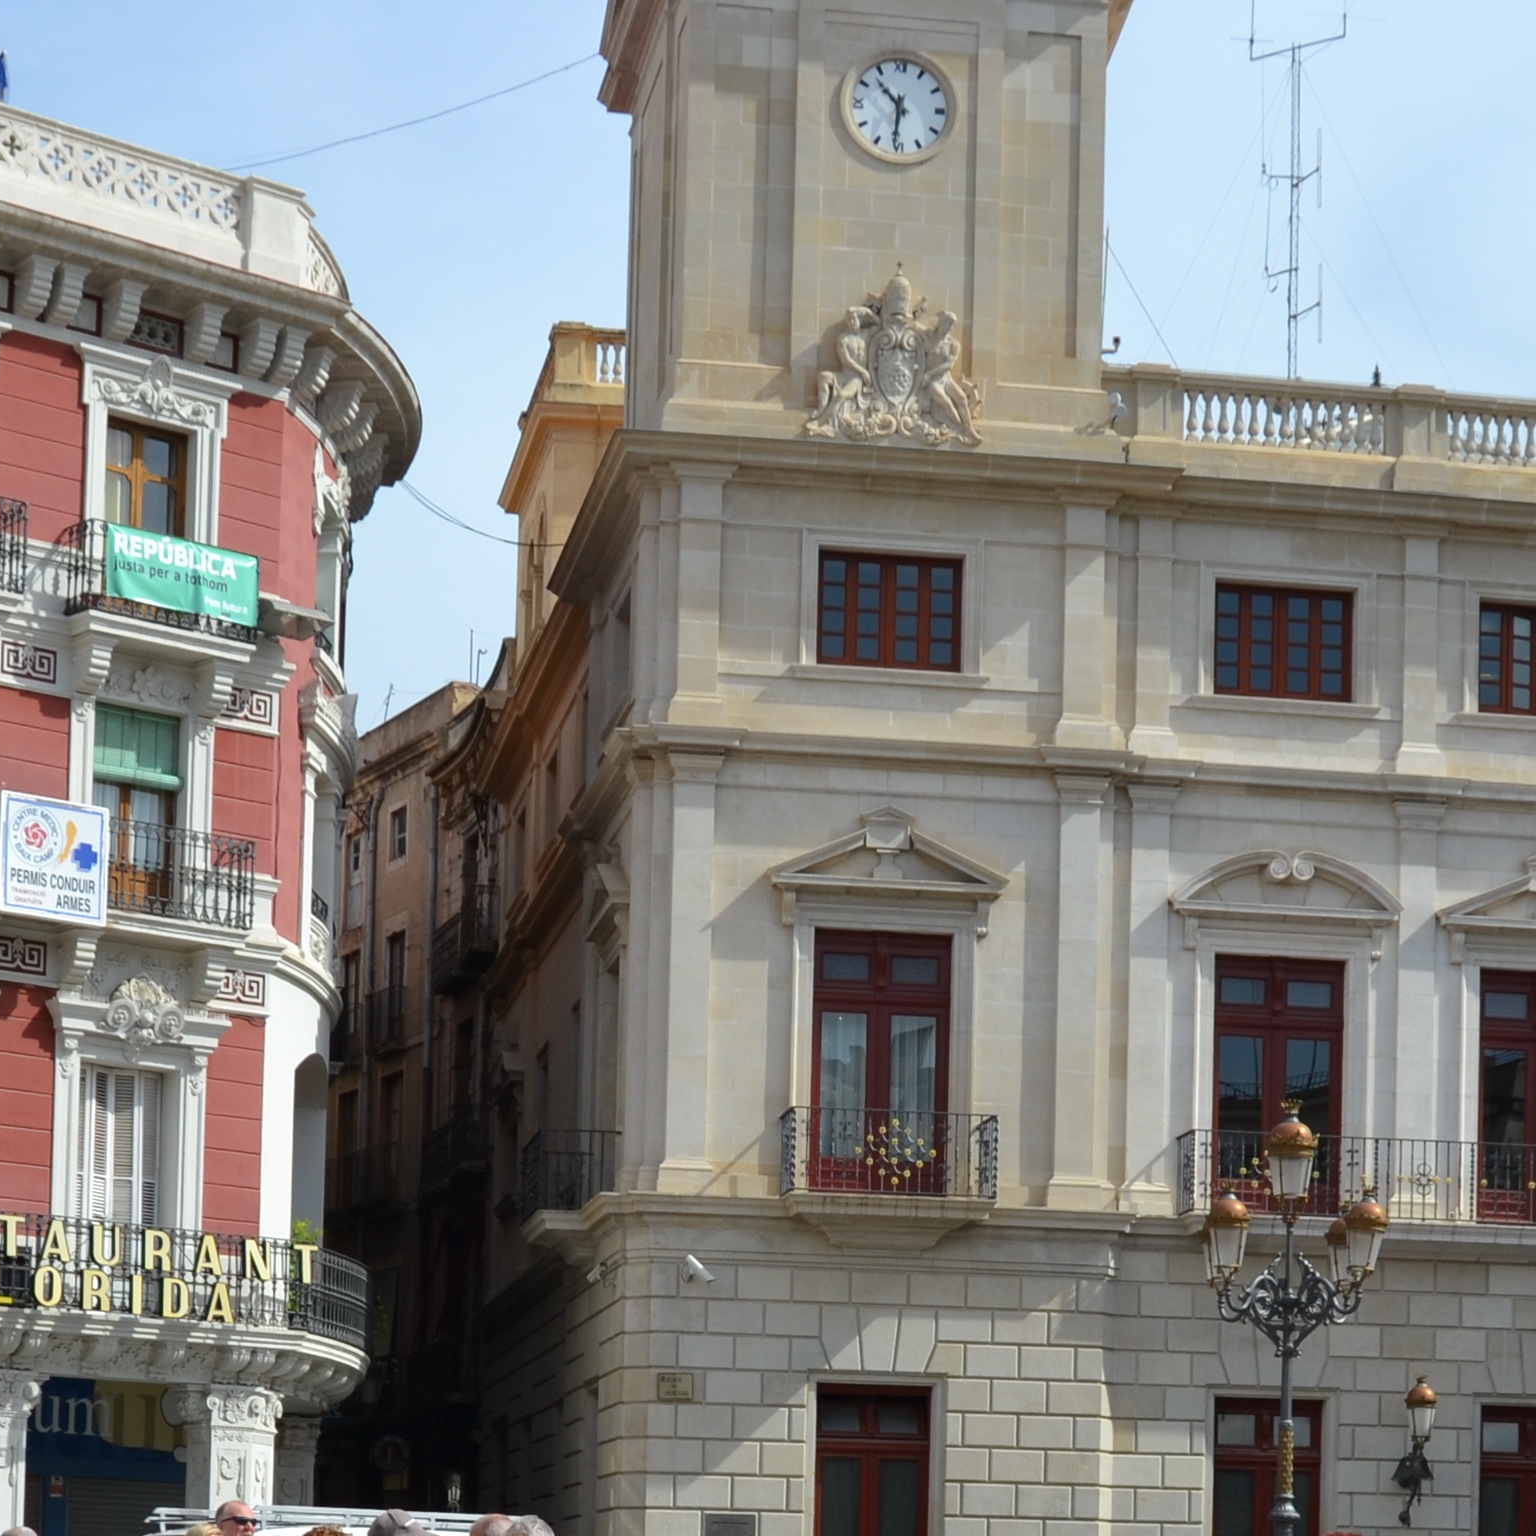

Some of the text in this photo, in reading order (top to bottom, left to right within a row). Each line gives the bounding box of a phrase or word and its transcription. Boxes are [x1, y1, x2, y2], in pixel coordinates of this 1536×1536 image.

[114, 531, 237, 580] REPÚBLICA
[114, 557, 228, 593] justa per a tothom
[12, 807, 39, 832] CENTRE
[50, 874, 96, 895] CONDUIR
[56, 894, 91, 913] ARMES
